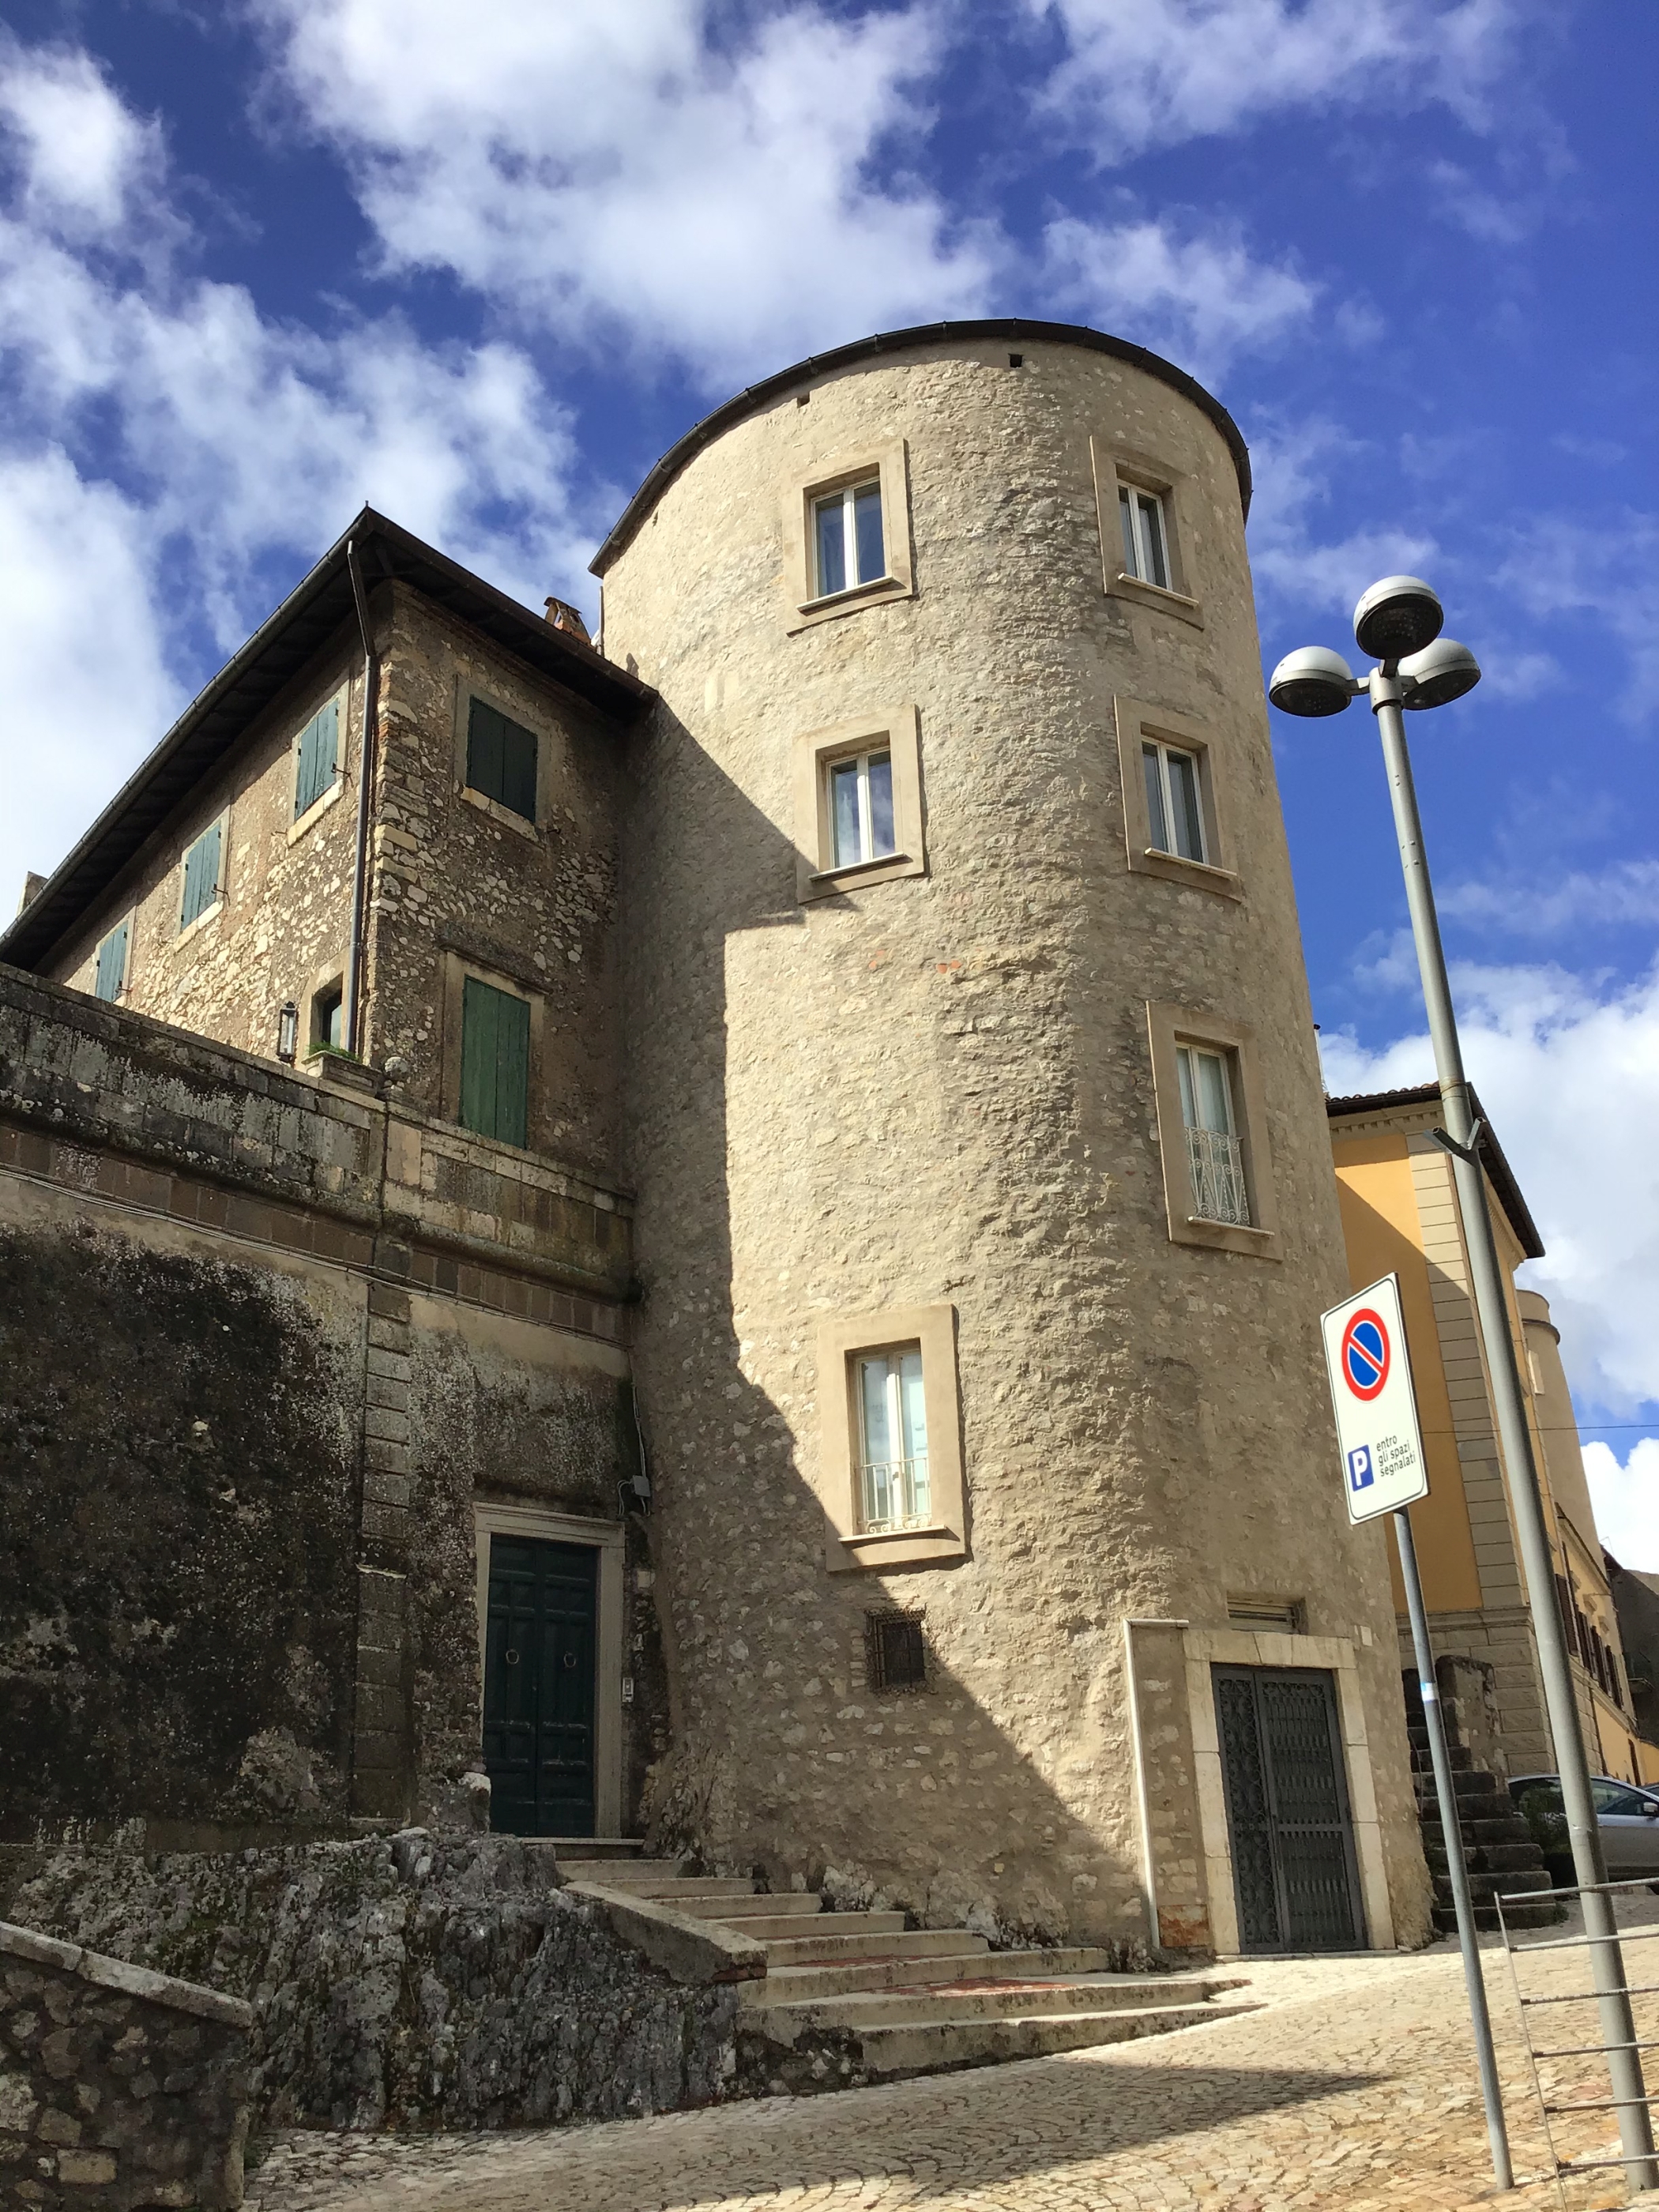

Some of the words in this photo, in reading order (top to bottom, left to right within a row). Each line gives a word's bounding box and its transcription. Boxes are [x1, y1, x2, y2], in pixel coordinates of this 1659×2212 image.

[1376, 1435, 1398, 1451] entro
[1378, 1450, 1389, 1467] gli
[1390, 1439, 1410, 1460] spazi
[1352, 1450, 1367, 1487] P
[1380, 1450, 1416, 1477] segnalati
